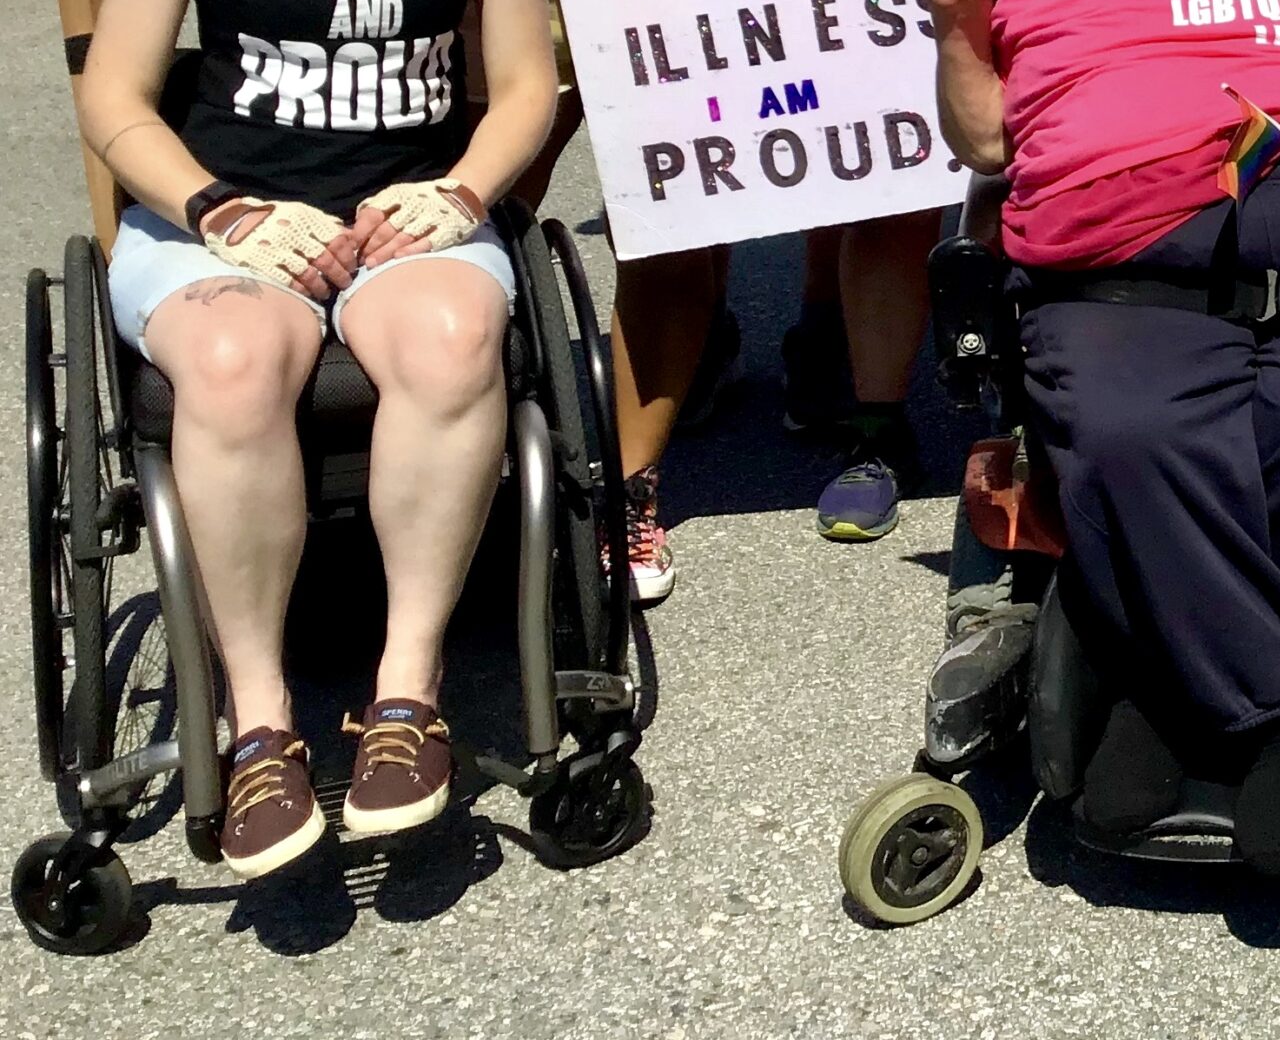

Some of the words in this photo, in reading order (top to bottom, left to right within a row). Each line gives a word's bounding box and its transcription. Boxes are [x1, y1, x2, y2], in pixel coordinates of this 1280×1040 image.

[233, 30, 455, 133] PROUD
[706, 96, 722, 122] I
[758, 79, 820, 119] AM
